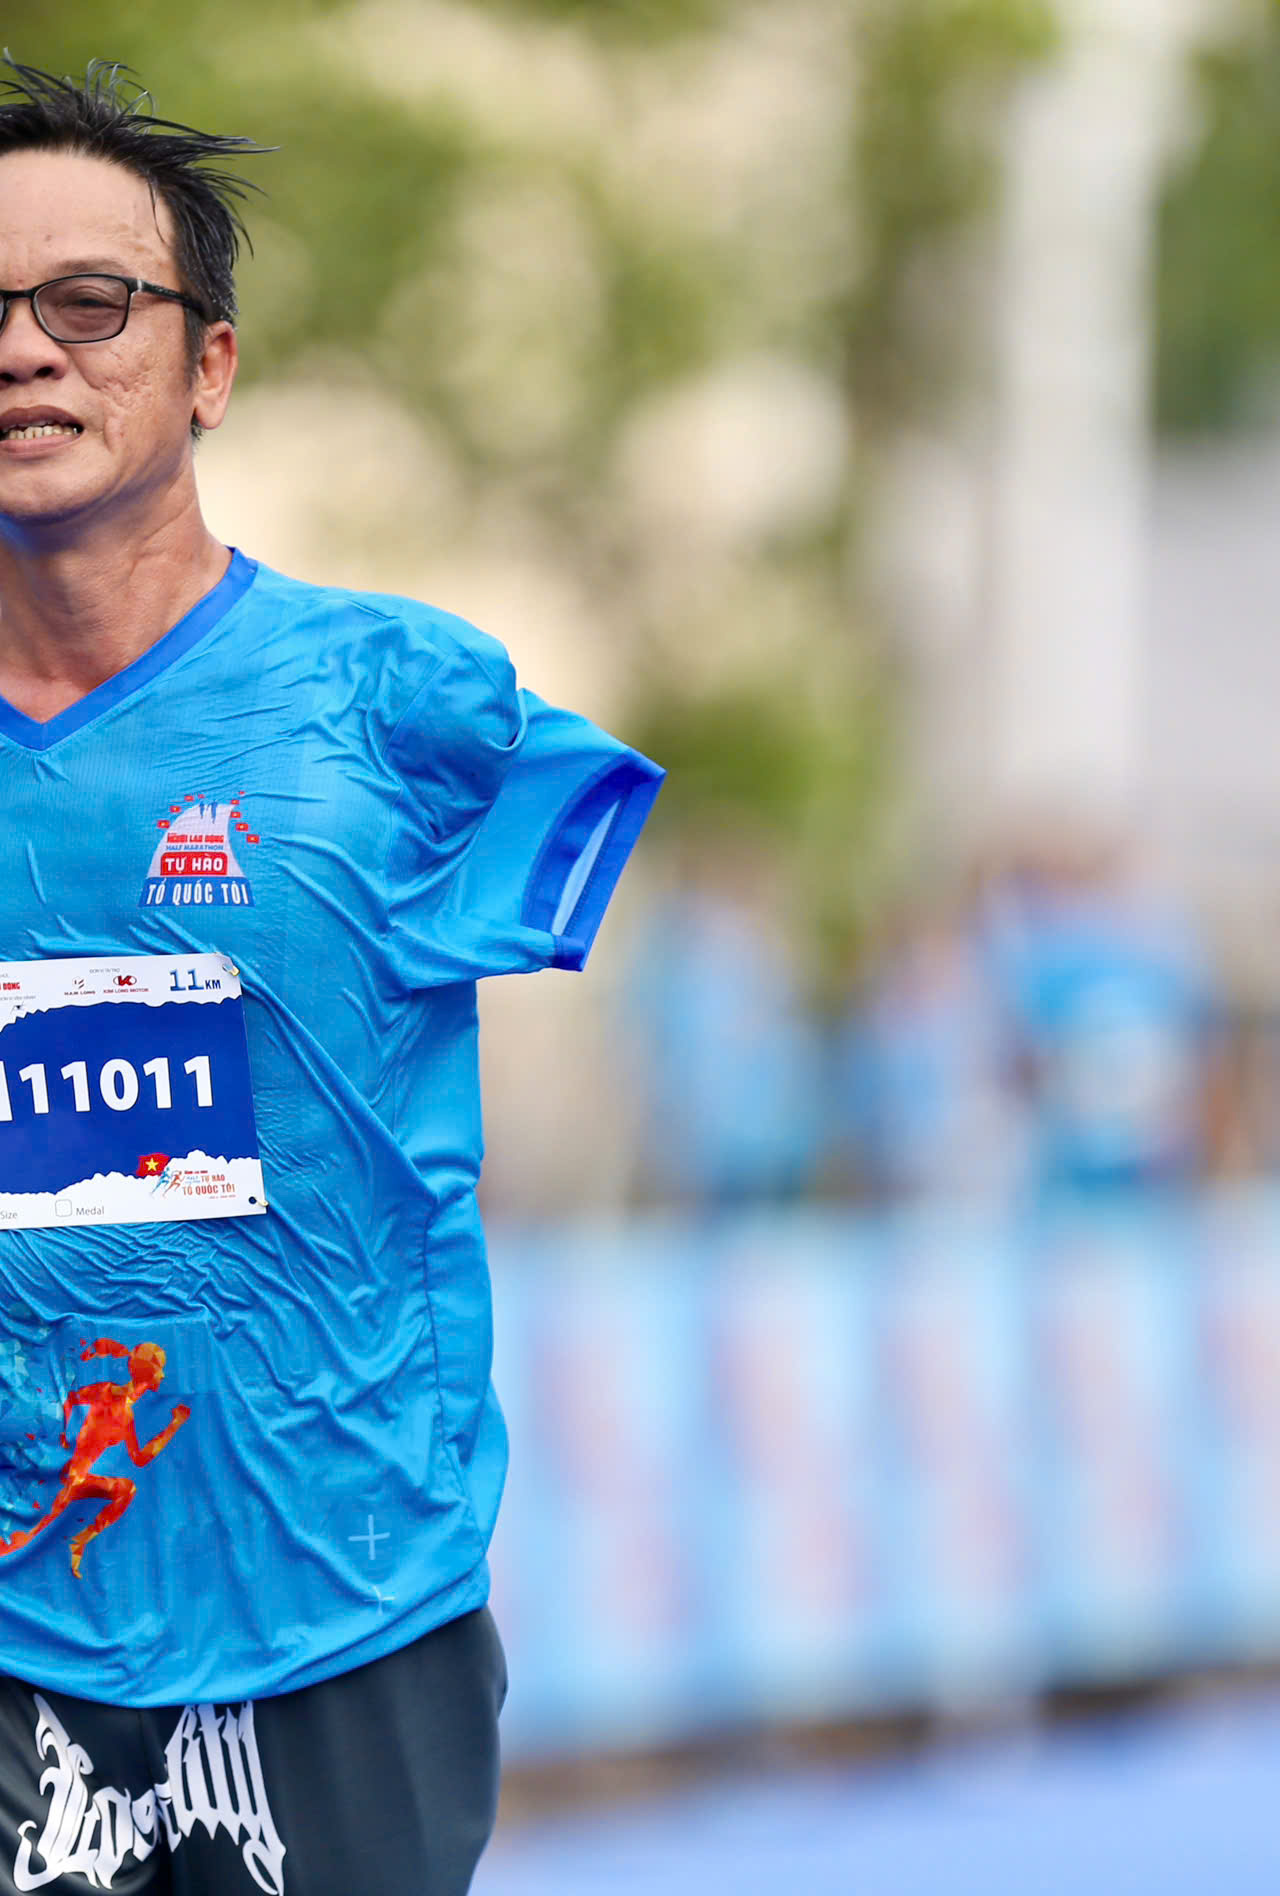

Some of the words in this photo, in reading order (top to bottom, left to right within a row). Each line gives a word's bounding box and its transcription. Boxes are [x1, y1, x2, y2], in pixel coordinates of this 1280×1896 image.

[192, 853, 224, 871] HÀO
[170, 968, 204, 992] 11
[205, 979, 222, 990] KM
[0, 1210, 18, 1220] Size
[75, 1206, 105, 1216] Medal
